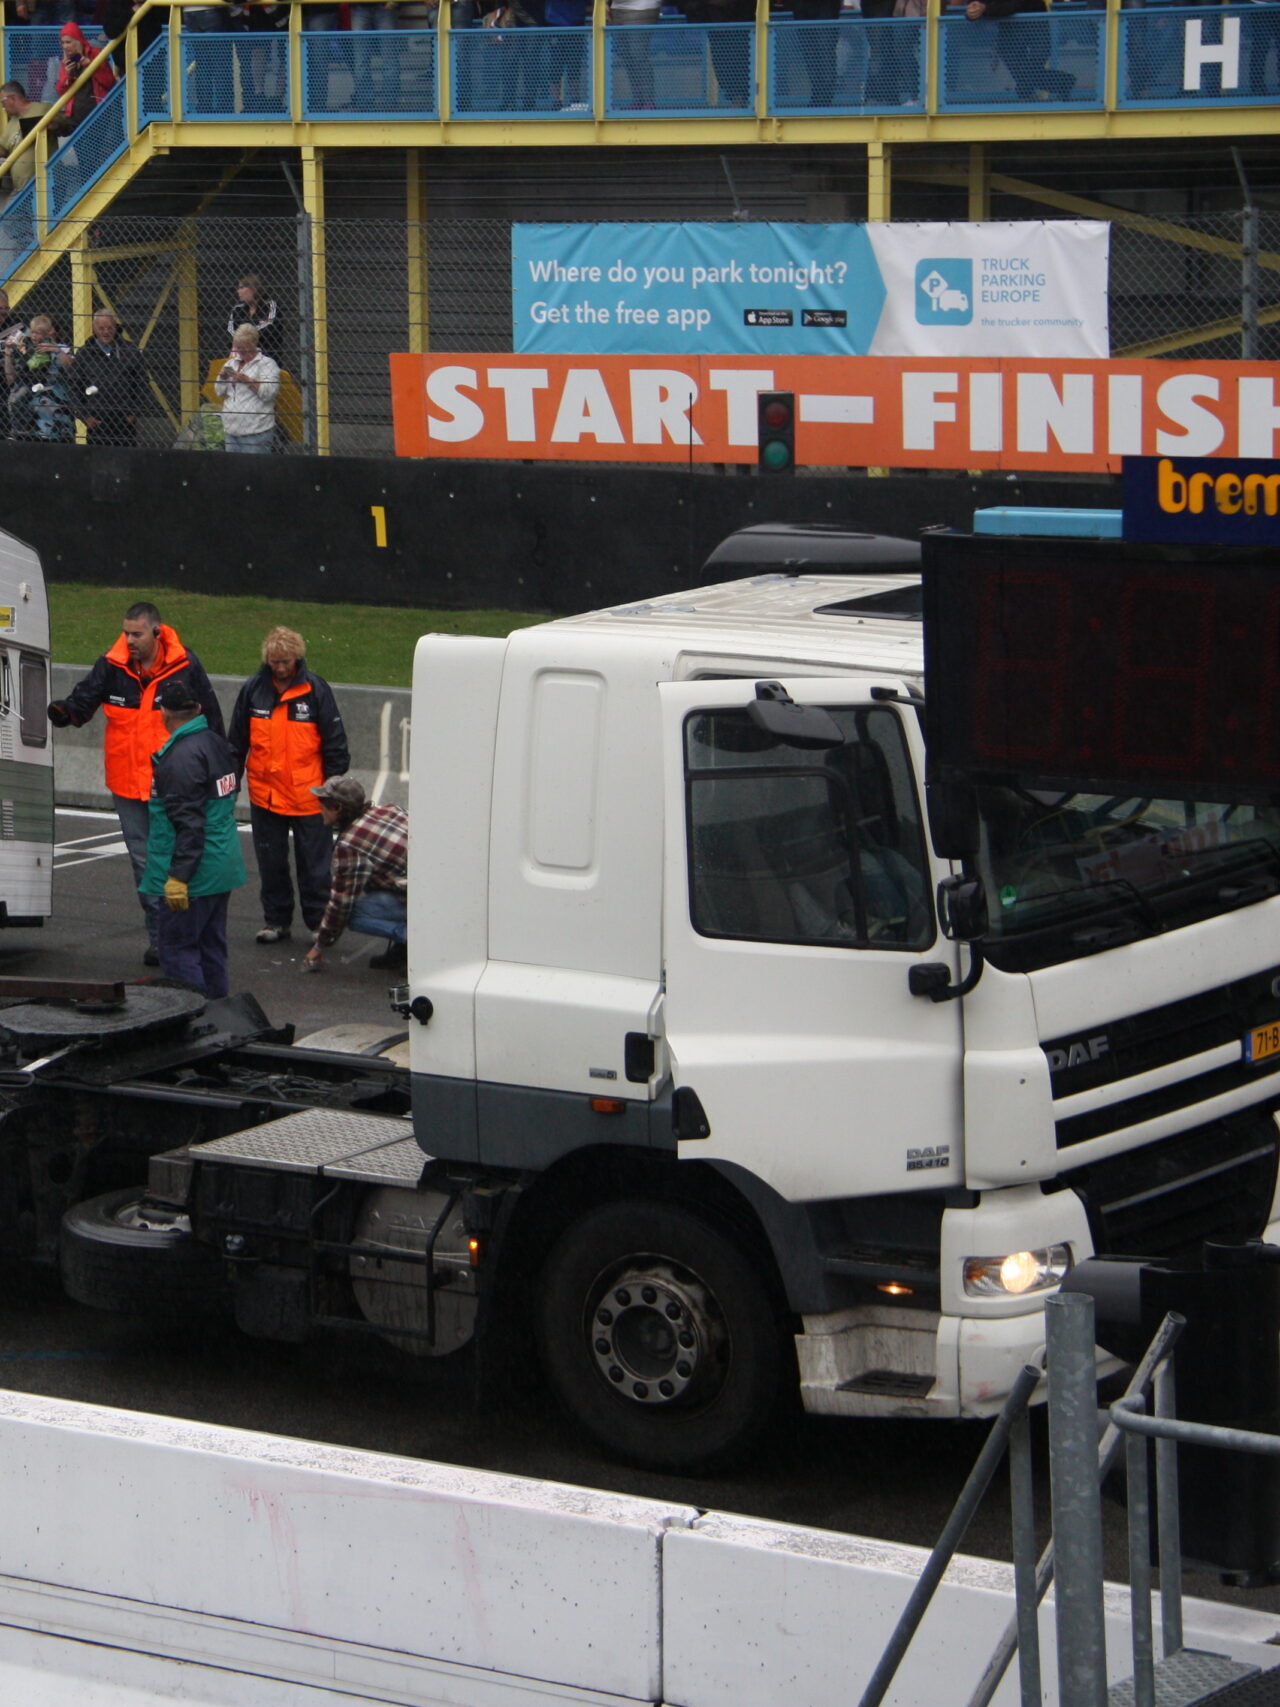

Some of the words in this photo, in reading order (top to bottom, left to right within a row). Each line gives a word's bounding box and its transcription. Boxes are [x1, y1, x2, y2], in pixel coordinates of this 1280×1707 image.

[1184, 17, 1240, 90] H
[529, 260, 601, 283] Where
[608, 259, 637, 283] do
[643, 265, 685, 289] you
[692, 260, 743, 289] park
[749, 261, 848, 290] tonight?
[981, 258, 1030, 271] TRUCK
[981, 273, 1046, 287] PARKING
[981, 290, 1041, 302] EUROPE
[529, 301, 570, 324] Get
[574, 301, 609, 324] the
[615, 301, 660, 324] free
[666, 307, 711, 331] app
[981, 317, 996, 326] the
[998, 317, 1031, 326] trucker
[1033, 318, 1084, 328] community
[426, 366, 774, 447] START
[902, 372, 1280, 459] FINISH
[371, 506, 387, 547] 1
[1047, 1035, 1109, 1073] DAF
[907, 1145, 950, 1160] DAF
